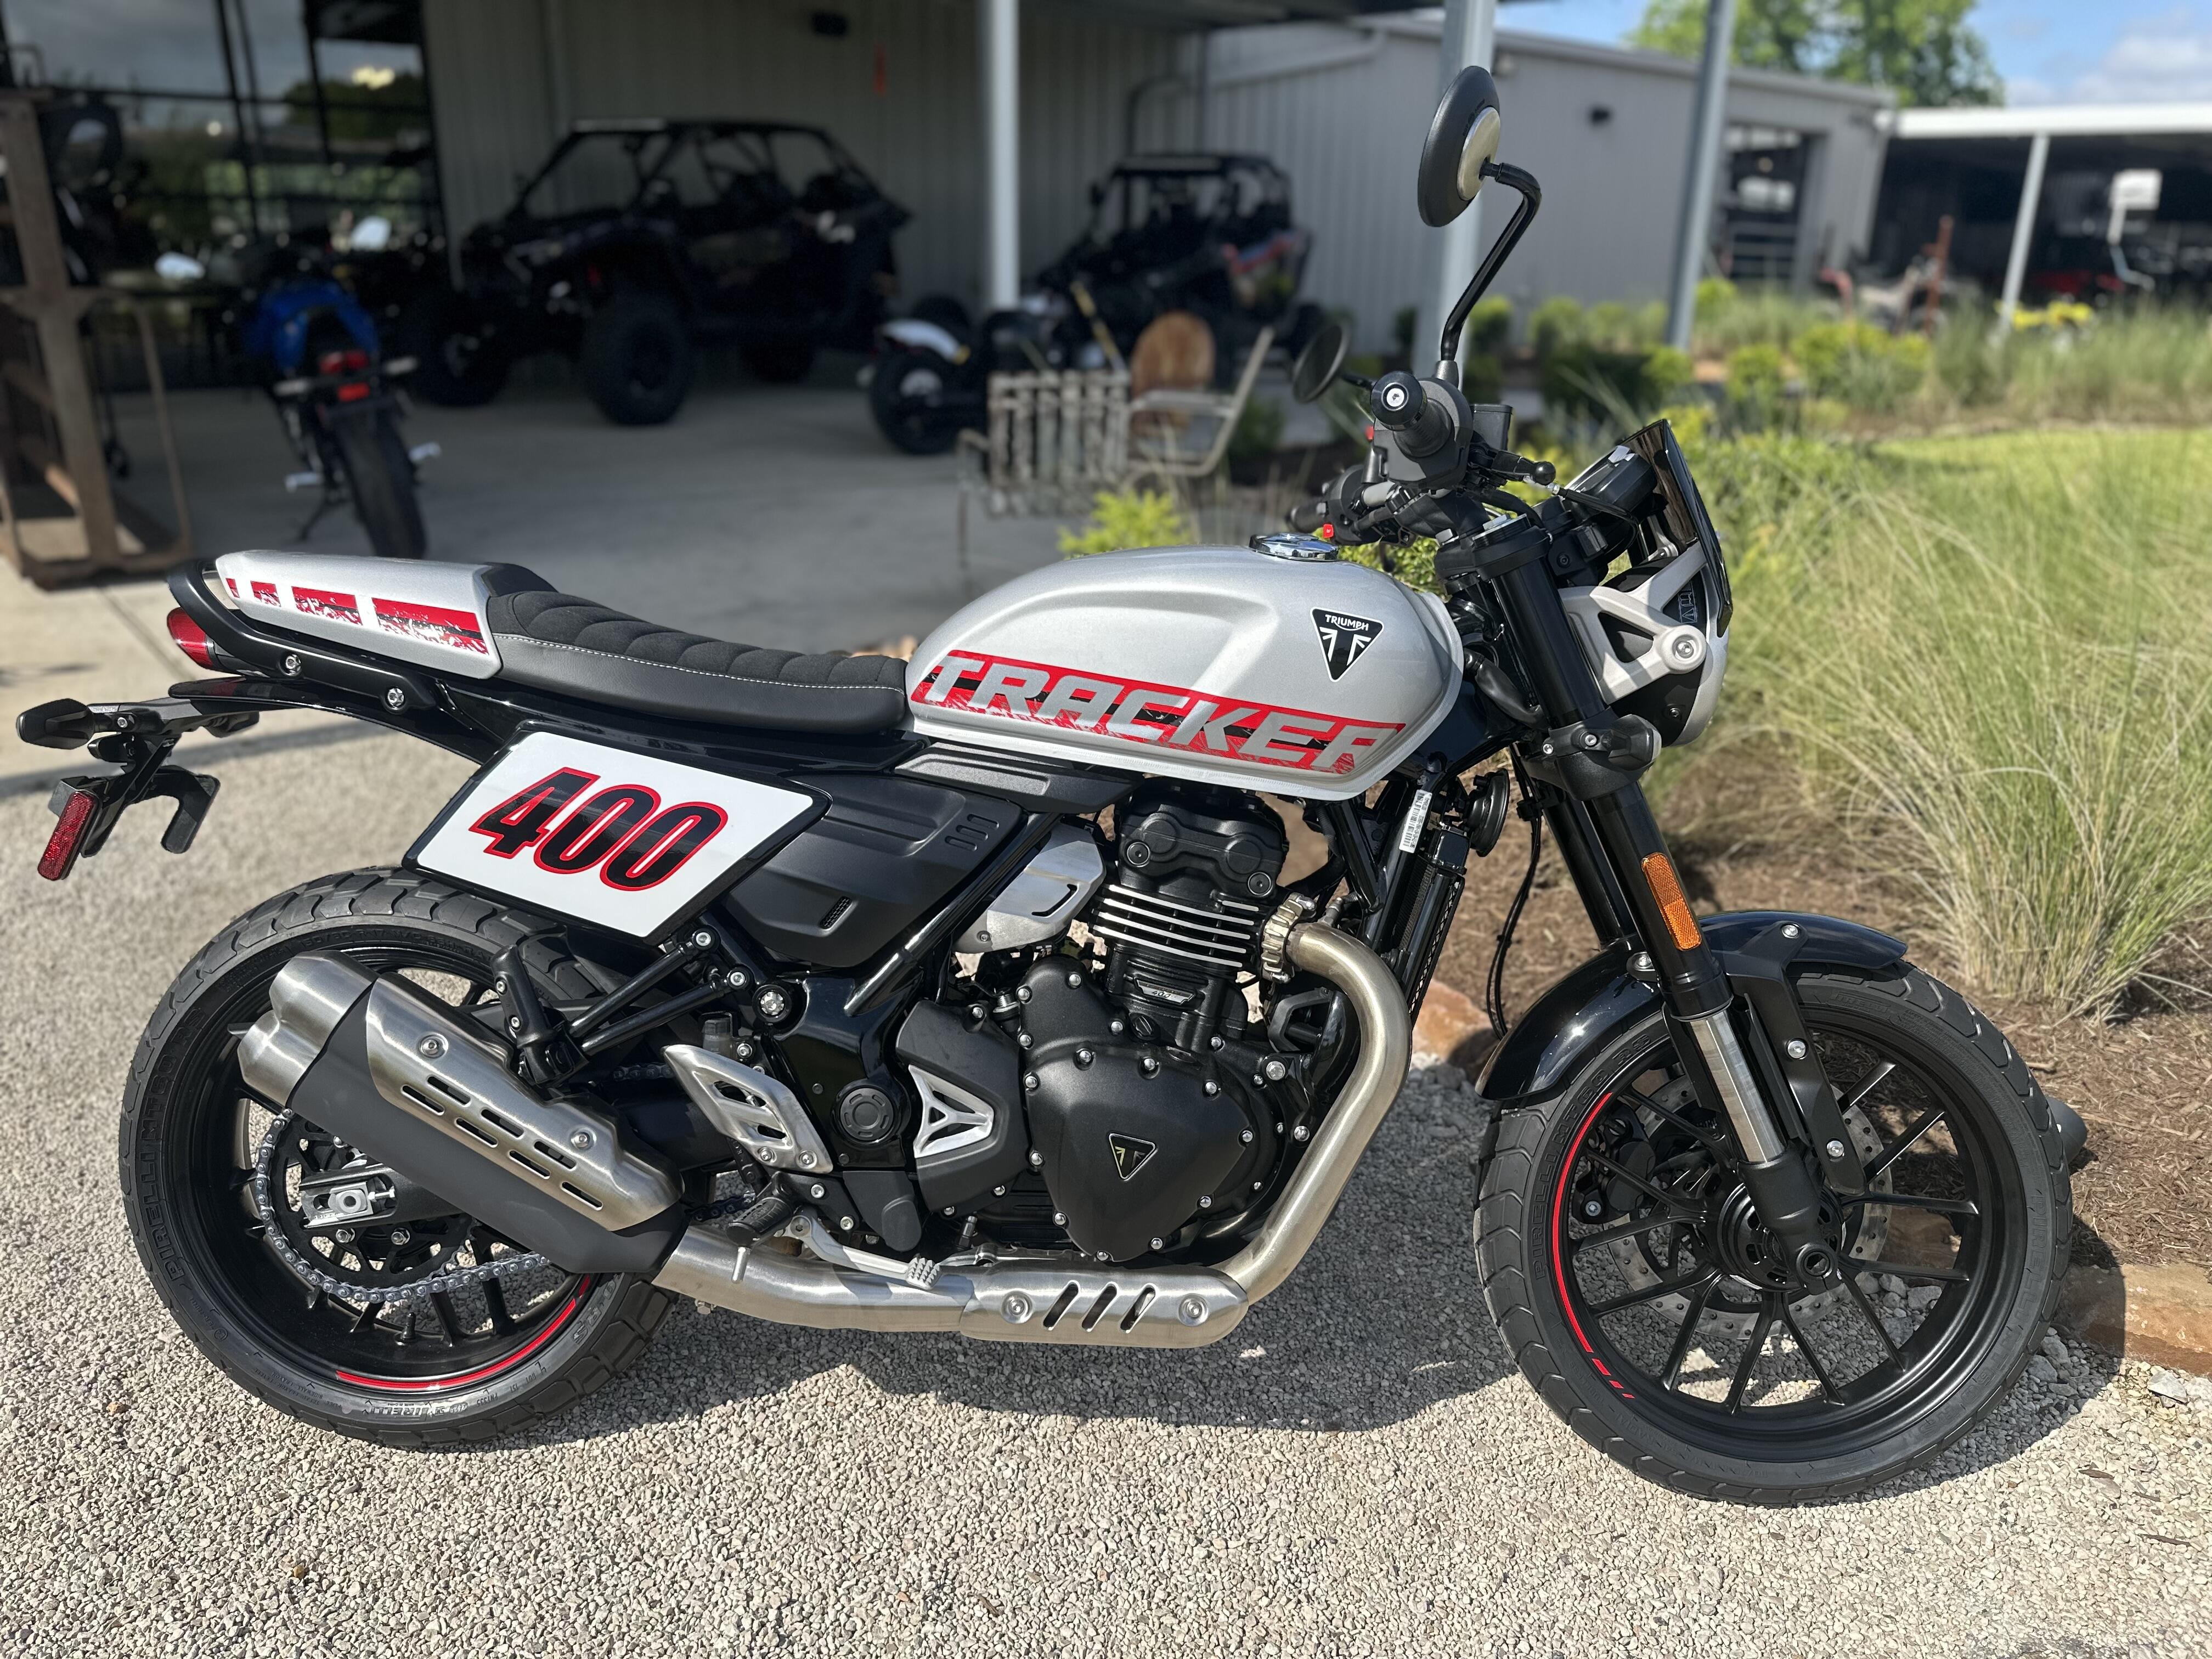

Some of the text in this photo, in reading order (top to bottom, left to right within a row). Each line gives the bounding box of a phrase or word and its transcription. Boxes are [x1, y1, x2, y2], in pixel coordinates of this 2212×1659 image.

[1325, 614, 1369, 631] TRIUMPH
[926, 655, 1401, 769] TRACKER
[468, 766, 729, 891] 400
[139, 1008, 206, 1282] PIRELLI MT60 RS
[1531, 1033, 1651, 1280] PIRELLI MT60 RS
[2016, 1195, 2048, 1319] PIRELLI
[370, 1406, 430, 1422] PIRELLI
